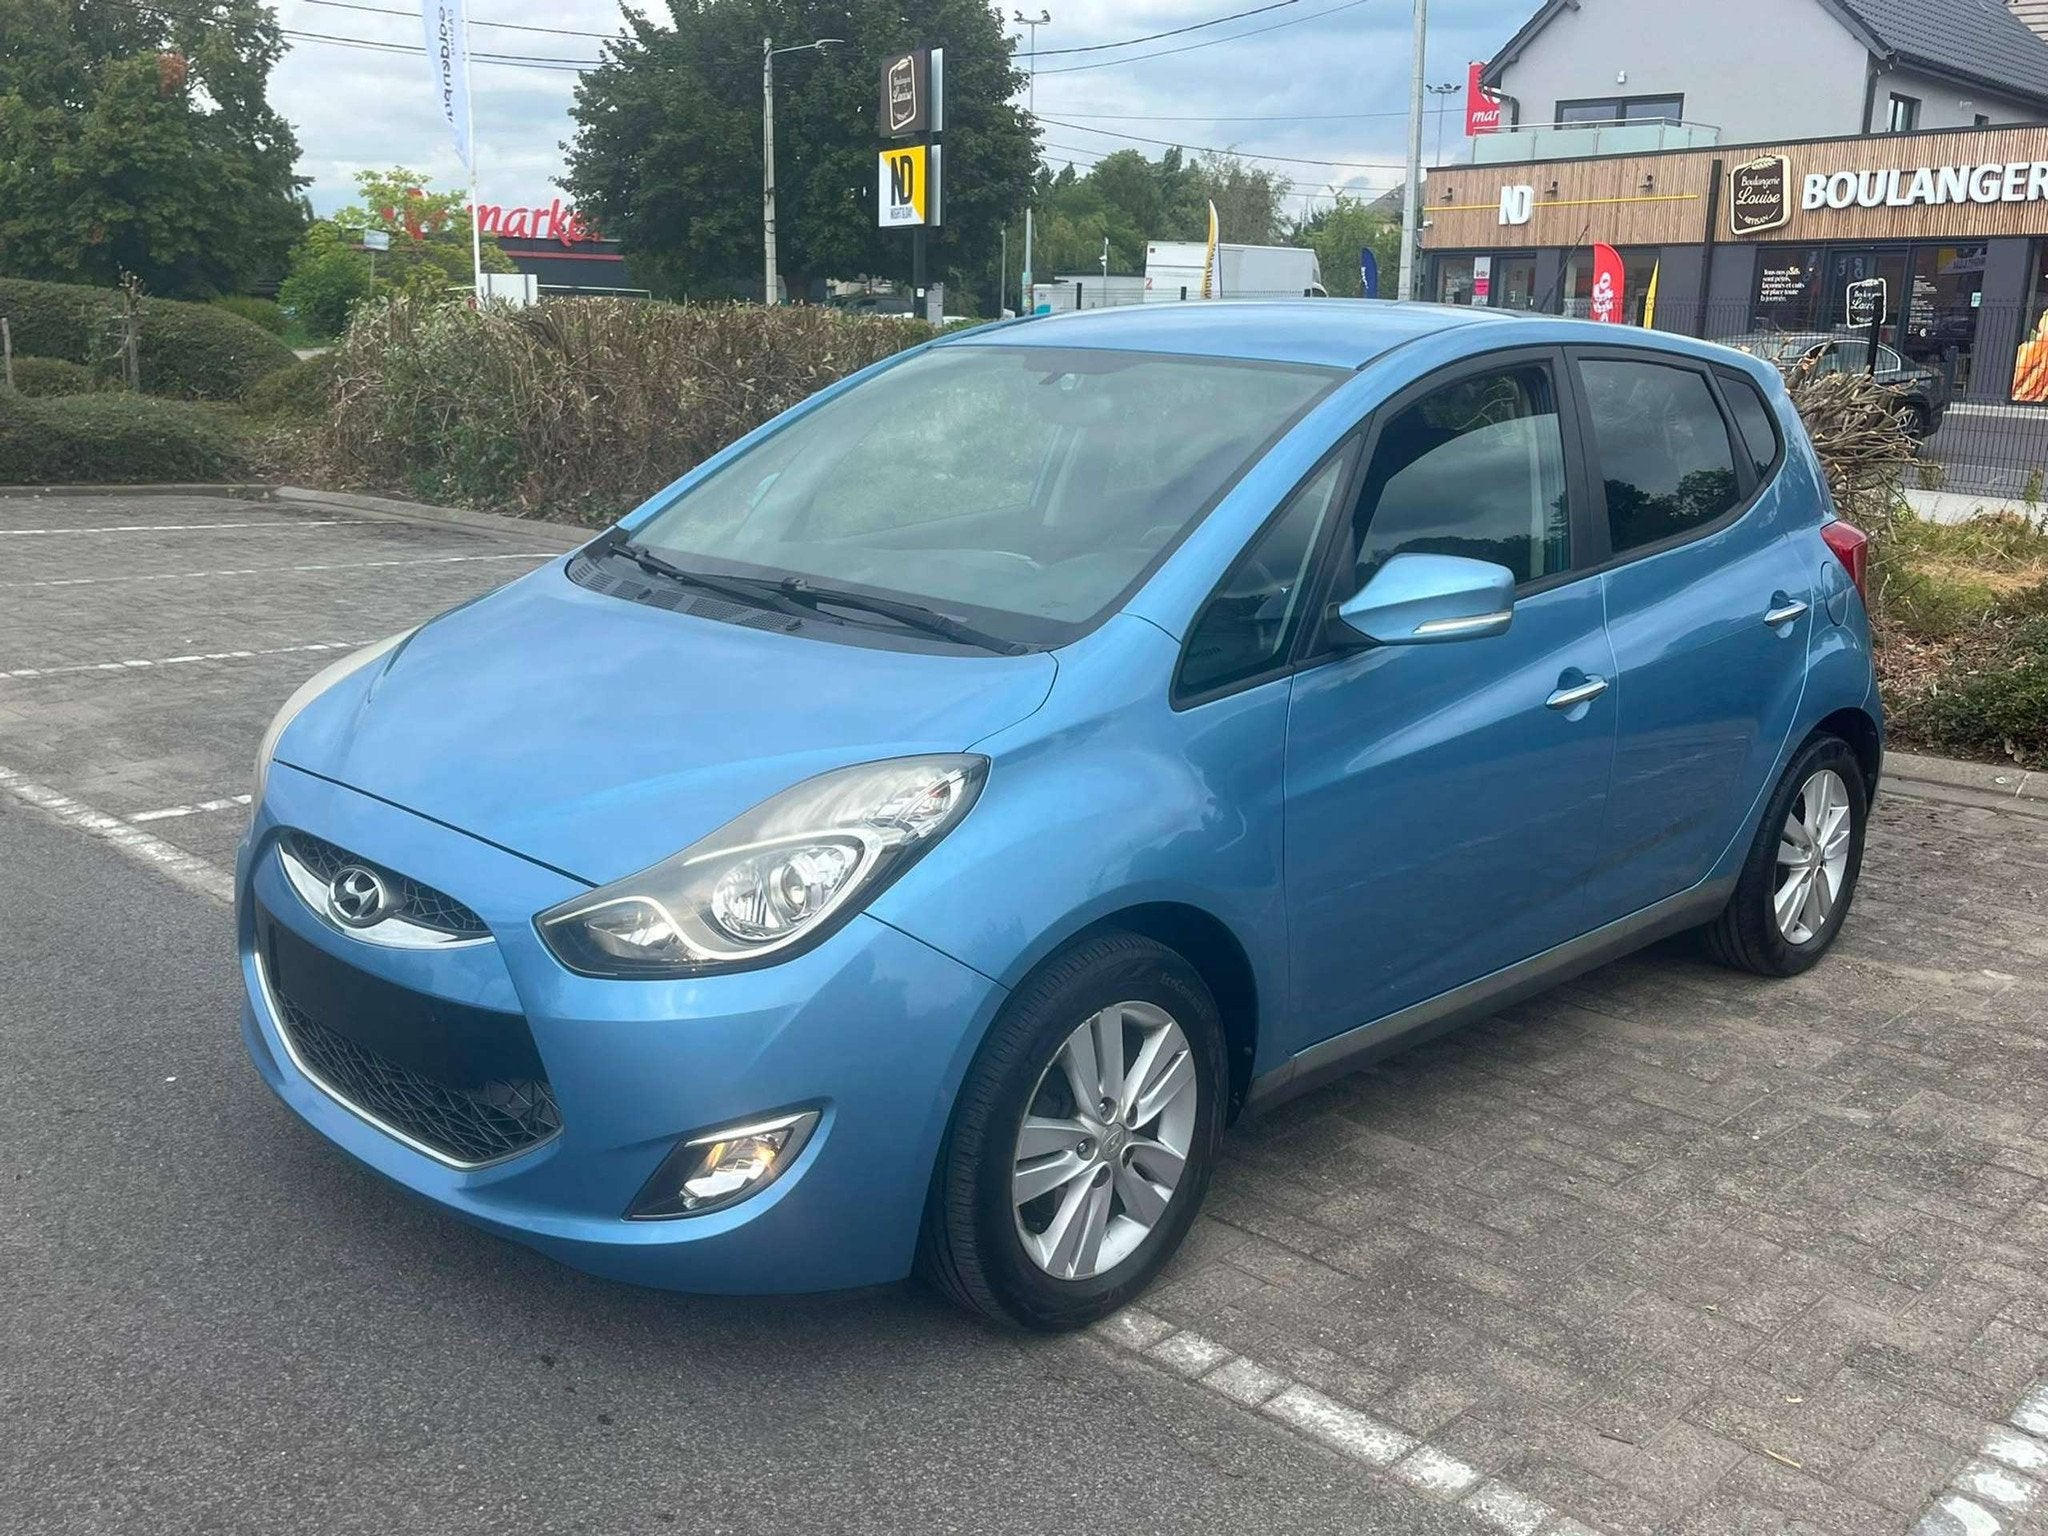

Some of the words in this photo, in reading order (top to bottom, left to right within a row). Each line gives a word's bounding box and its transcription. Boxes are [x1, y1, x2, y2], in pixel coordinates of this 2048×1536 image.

[891, 155, 913, 206] ND
[1735, 186, 1781, 205] Louise
[1741, 175, 1780, 189] Boulangerie
[1801, 161, 2048, 210] BOULANGER
[1499, 185, 1534, 225] ND
